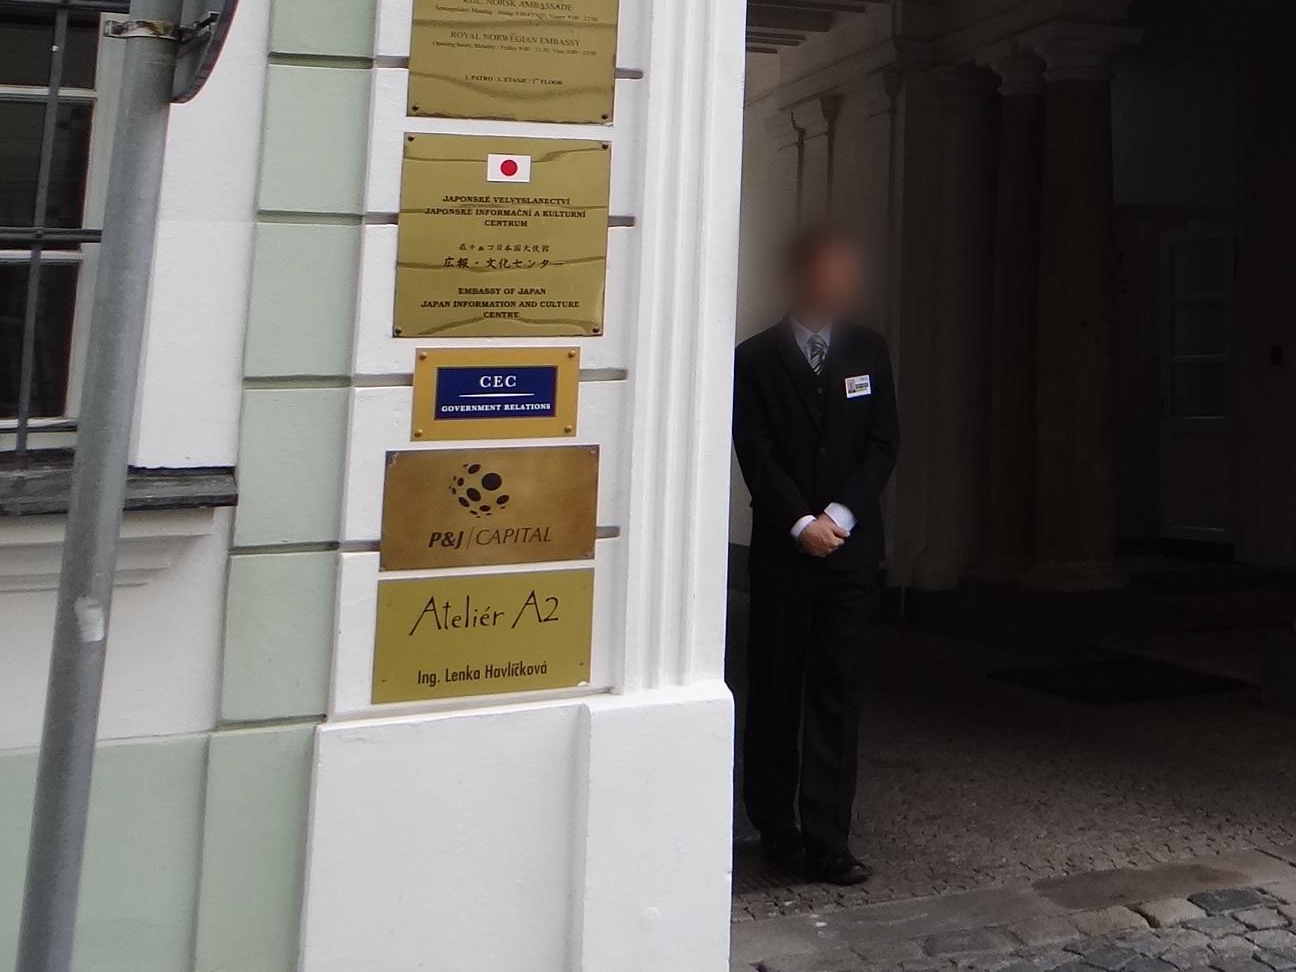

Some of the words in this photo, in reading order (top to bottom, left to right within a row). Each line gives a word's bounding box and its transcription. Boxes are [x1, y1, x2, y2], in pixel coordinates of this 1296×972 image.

[518, 1, 573, 11] AMBASSADE
[450, 31, 480, 40] ROYAL
[483, 33, 537, 44] NORWEGIAN
[540, 36, 580, 47] EMBASSY
[534, 209, 540, 217] A
[484, 219, 528, 227] CENTRUM
[443, 257, 565, 269] 広報・文化センター
[458, 287, 500, 295] EMBASSY
[504, 287, 515, 295] OF
[420, 300, 450, 308] JAPAN
[453, 300, 516, 308] INFORMATION
[479, 375, 517, 388] CEC
[441, 404, 501, 412] GOVERNMENT
[503, 403, 551, 411] RELATIONS
[428, 530, 464, 549] P&J
[475, 526, 552, 546] CAPITAL
[409, 595, 504, 636] Ateliér
[511, 589, 560, 629] A2
[418, 669, 440, 688] Ing.
[444, 665, 481, 684] Lenka
[485, 661, 547, 680] Havlíčková
